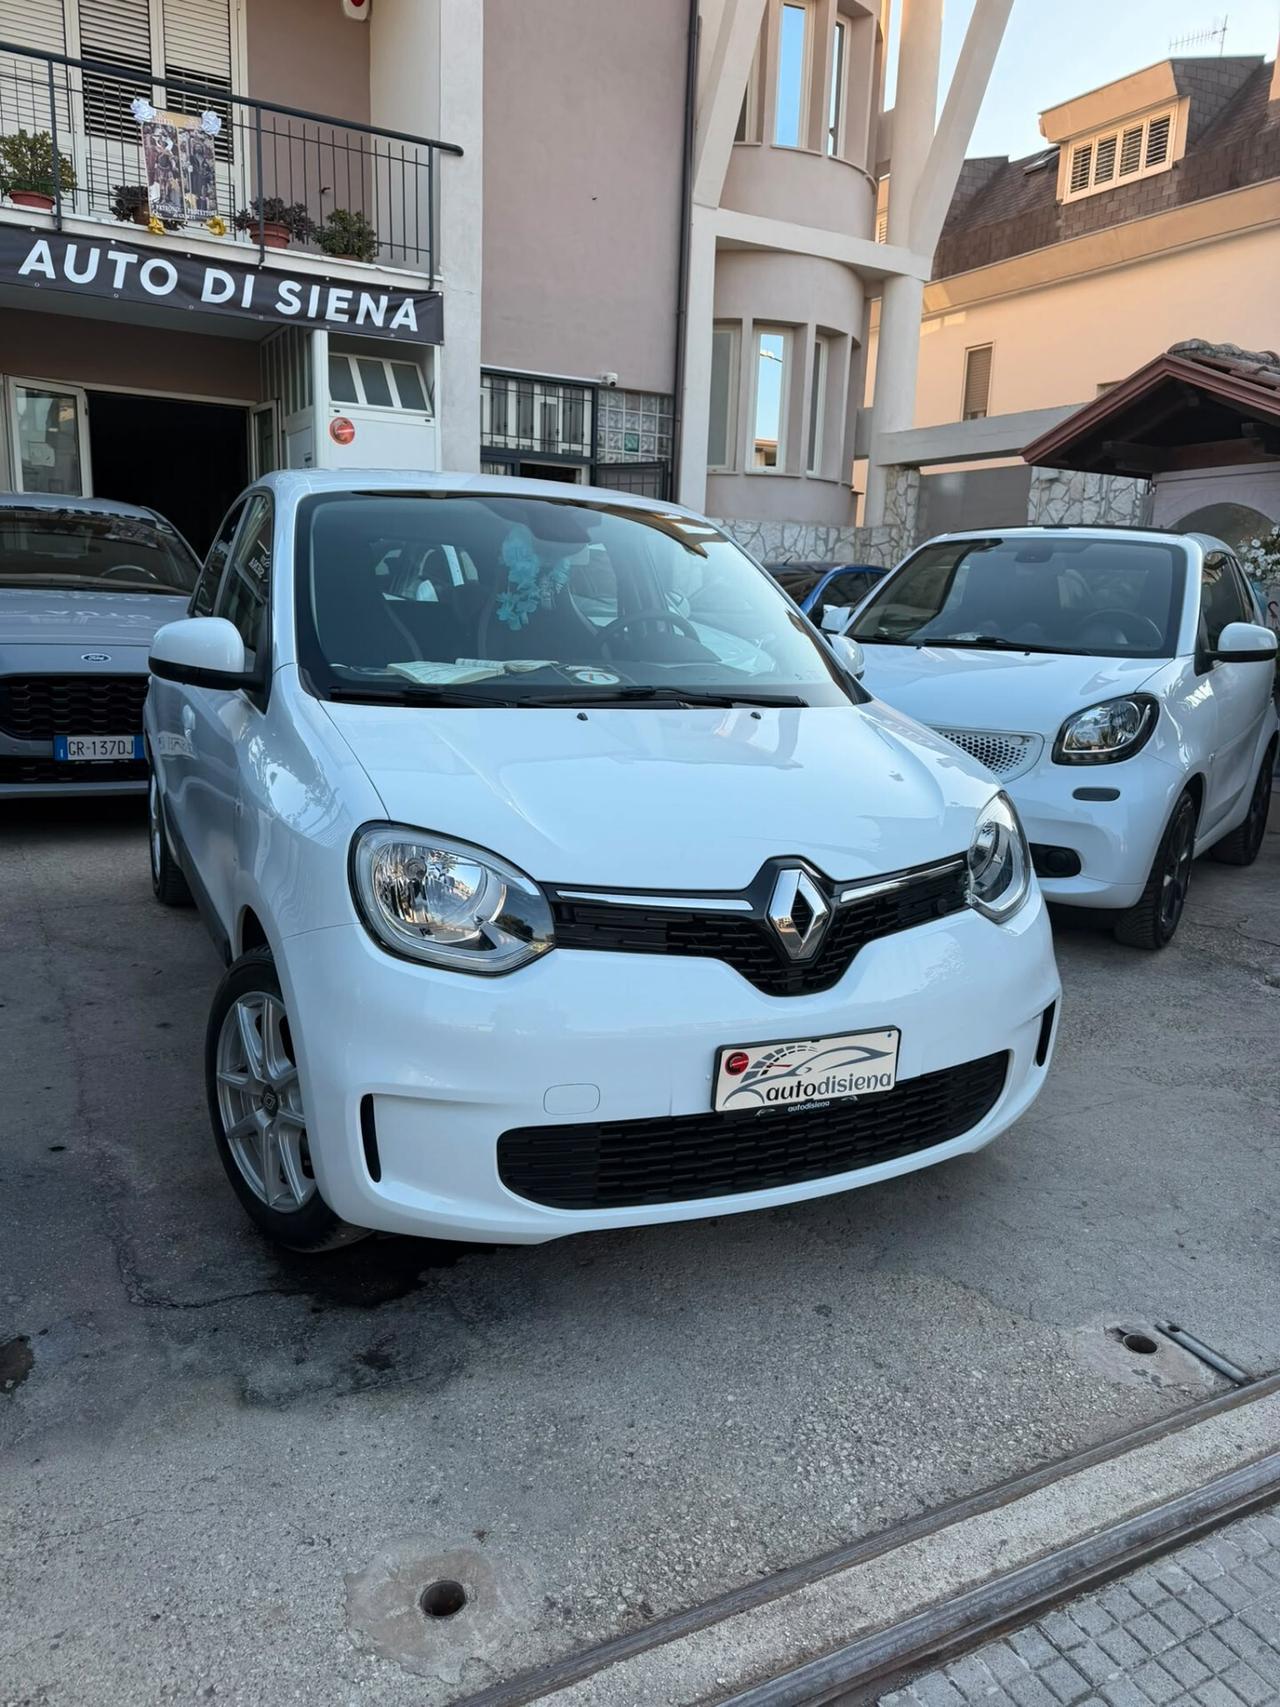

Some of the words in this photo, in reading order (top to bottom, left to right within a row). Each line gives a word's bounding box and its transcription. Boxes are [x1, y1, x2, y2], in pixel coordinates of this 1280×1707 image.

[18, 239, 179, 296] AUTO
[201, 267, 256, 309] DI
[275, 280, 419, 333] SIENA
[766, 1072, 892, 1102] autodisiena
